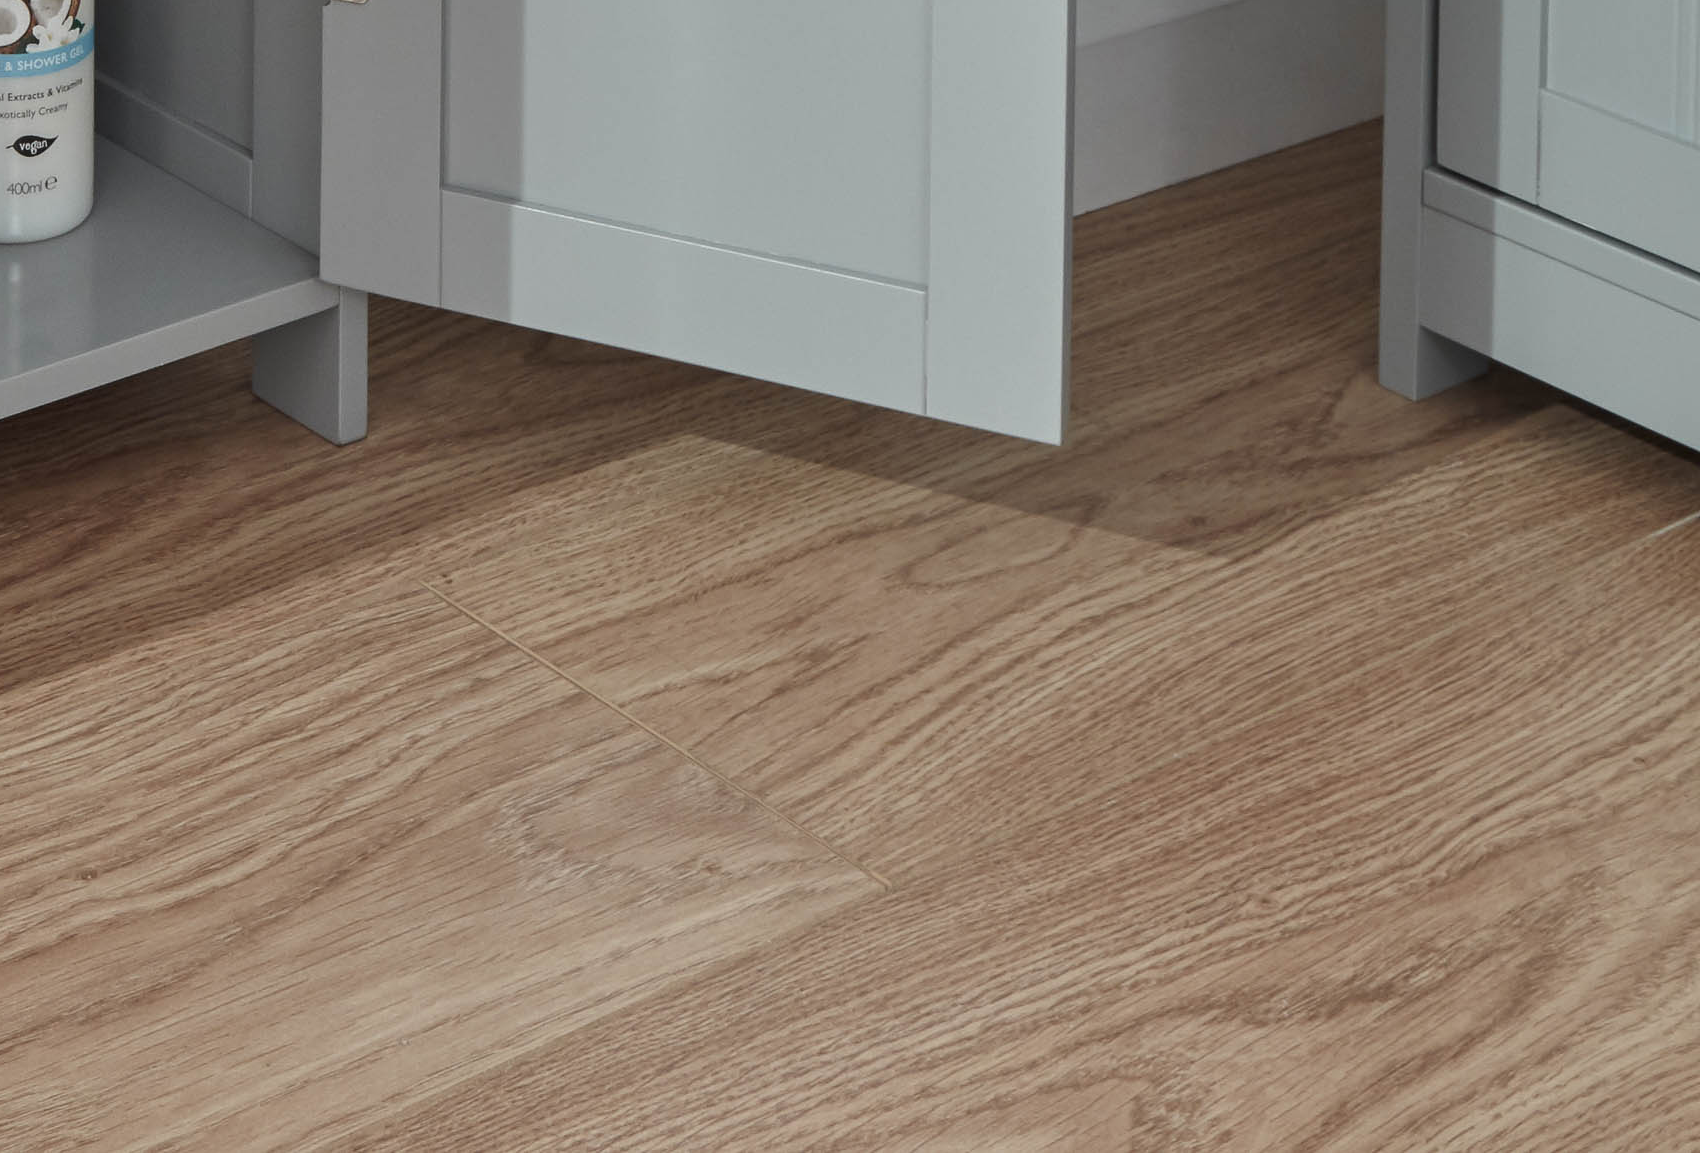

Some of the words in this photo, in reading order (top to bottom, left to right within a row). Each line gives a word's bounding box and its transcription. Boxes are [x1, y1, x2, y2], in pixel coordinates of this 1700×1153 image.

[4, 61, 13, 72] &
[17, 53, 68, 71] SHOWER
[7, 90, 45, 102] Extracts
[47, 87, 54, 98] &
[38, 102, 69, 116] Creamy
[19, 139, 49, 155] vegan
[6, 180, 43, 196] 400ml
